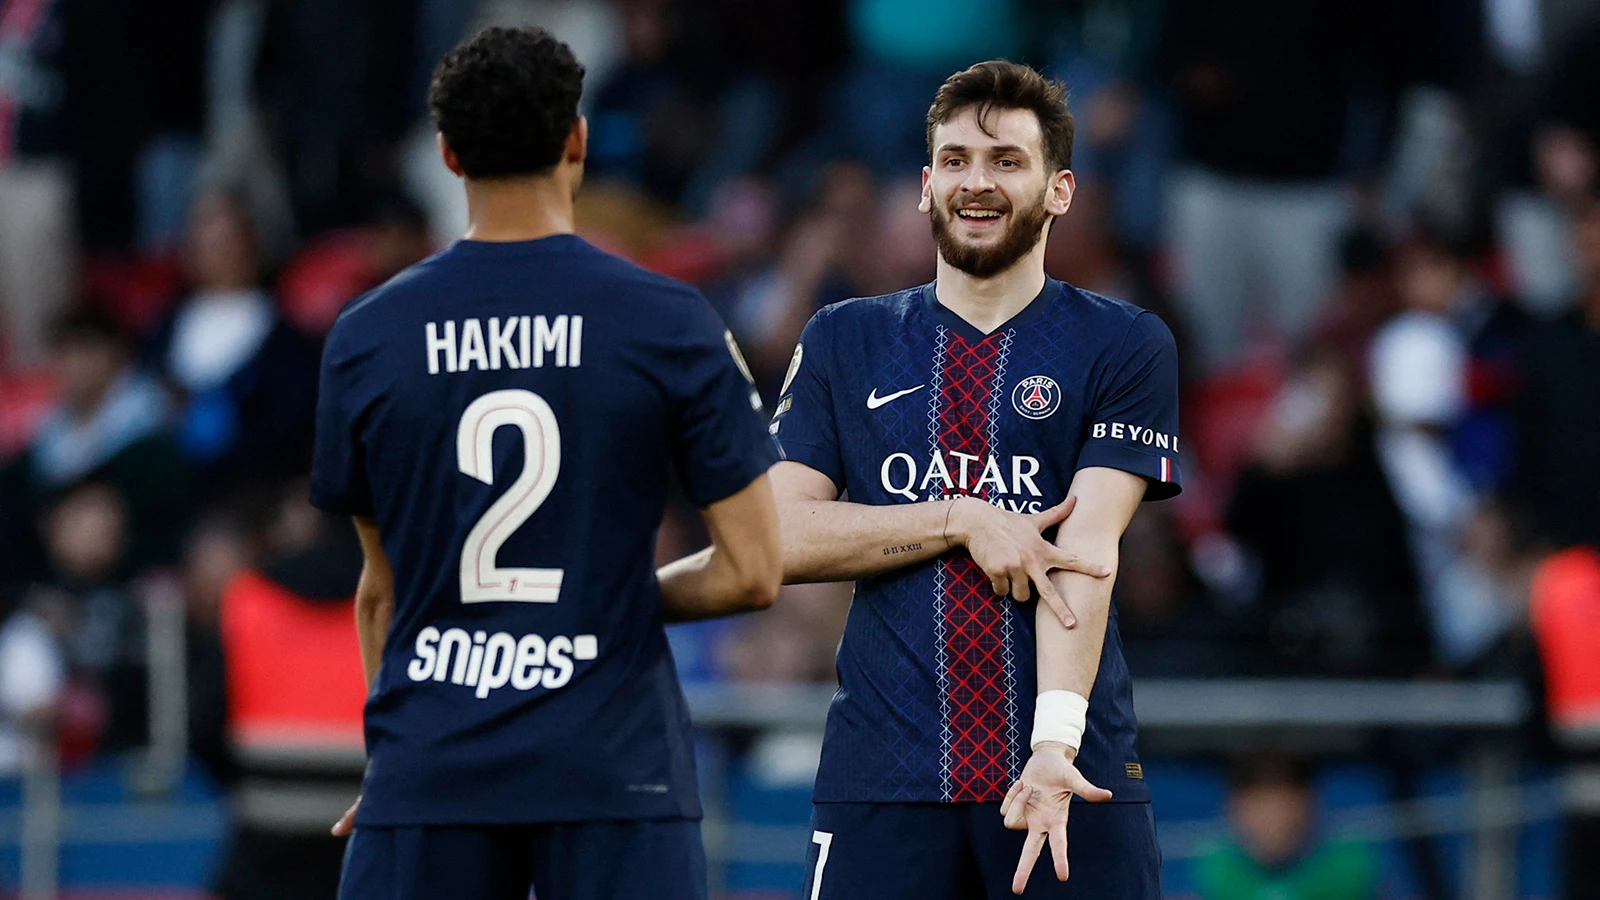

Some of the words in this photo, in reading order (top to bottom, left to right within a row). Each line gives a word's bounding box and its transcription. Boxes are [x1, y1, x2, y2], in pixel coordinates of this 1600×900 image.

[425, 315, 583, 375] HAKIMI
[1022, 377, 1054, 389] PARIS
[456, 388, 564, 604] 2
[880, 449, 1042, 502] QATAR
[812, 830, 833, 900] 7
